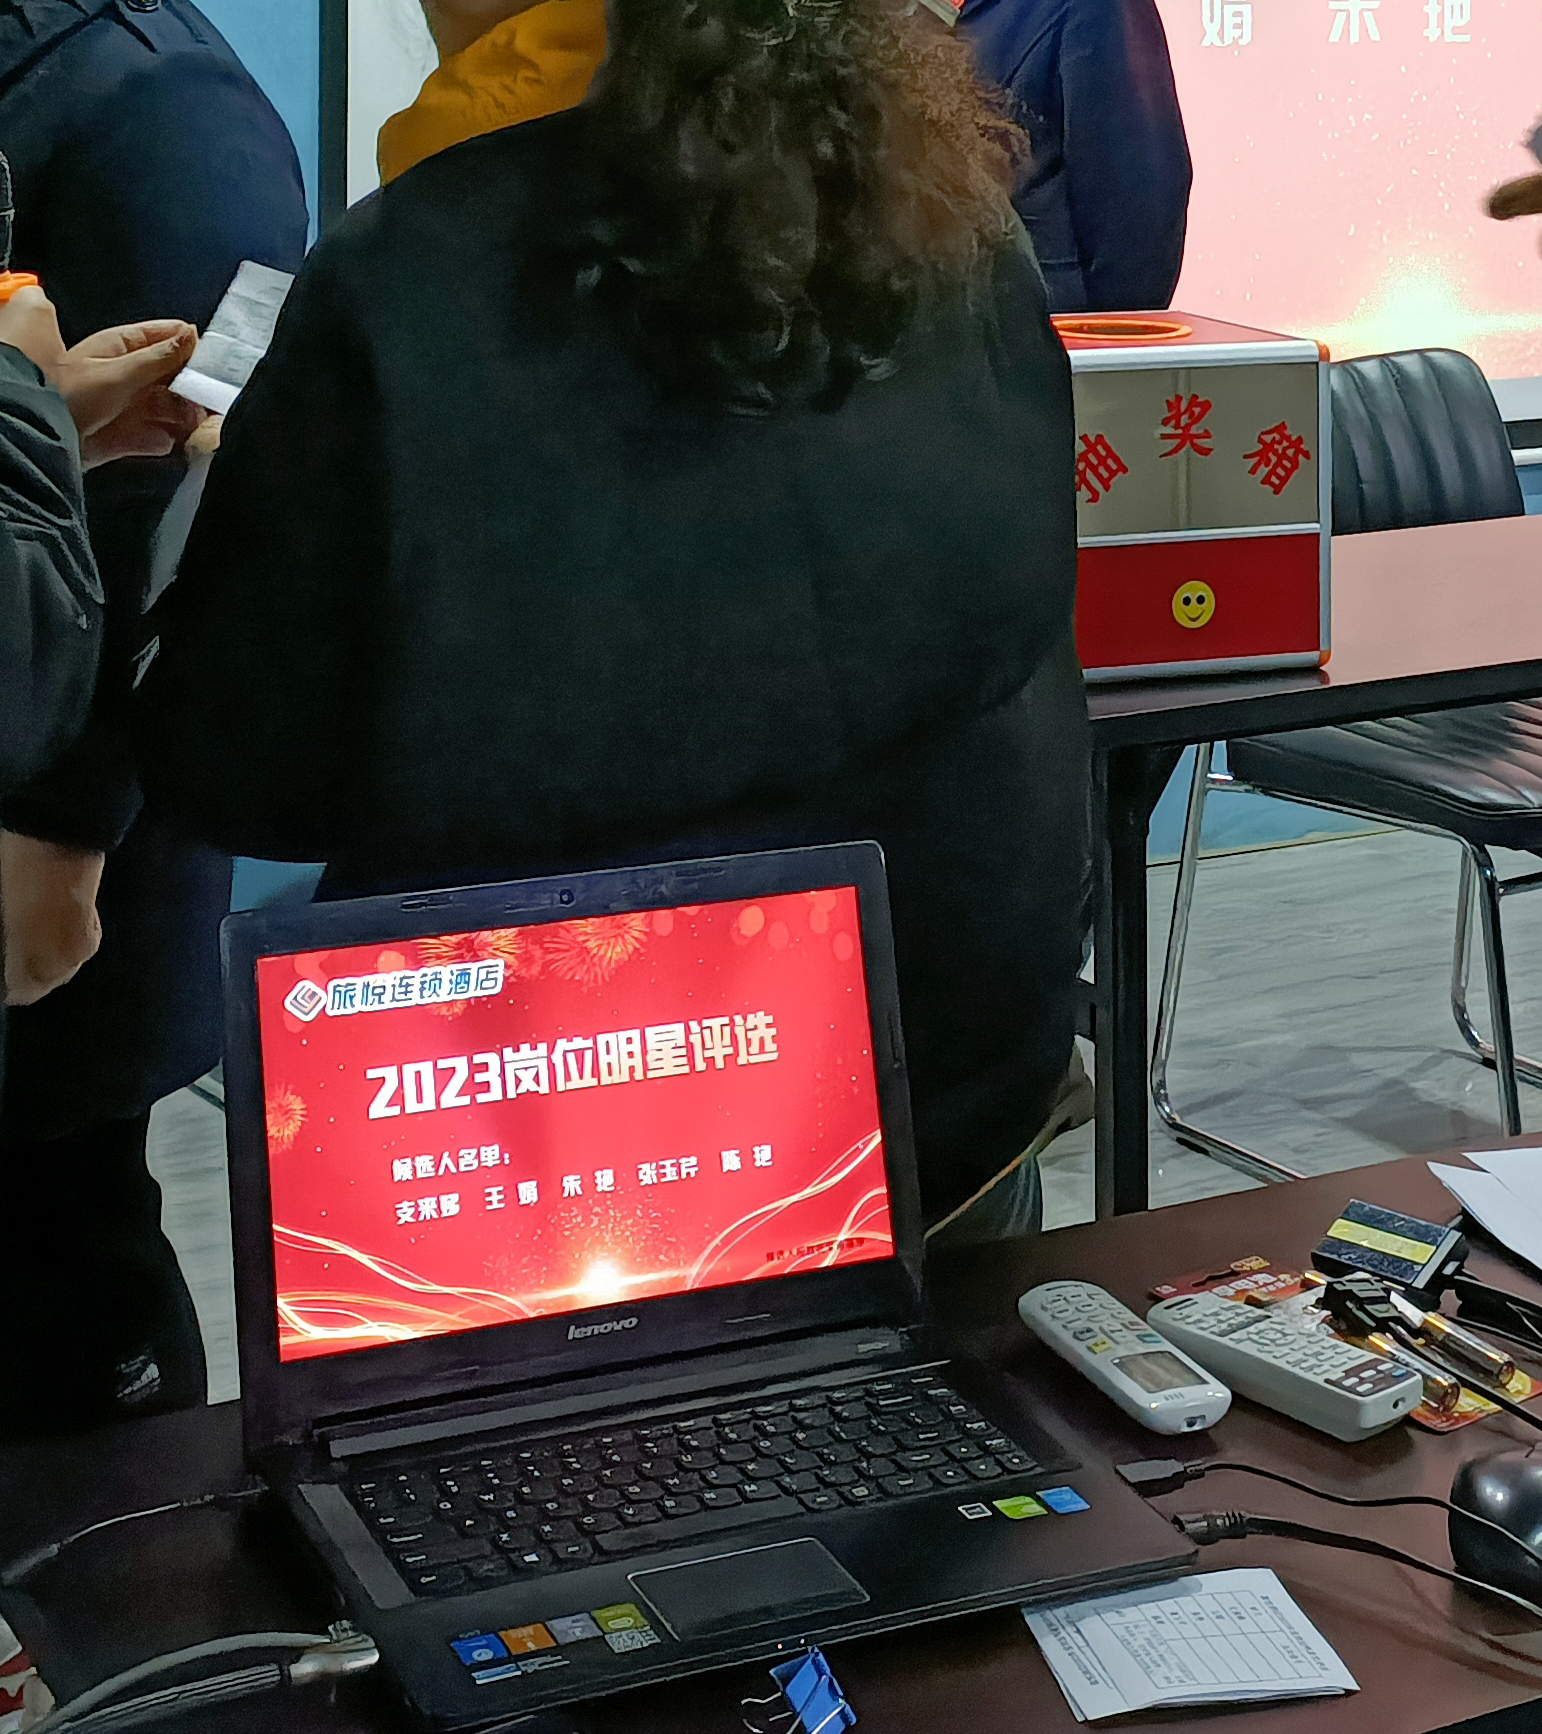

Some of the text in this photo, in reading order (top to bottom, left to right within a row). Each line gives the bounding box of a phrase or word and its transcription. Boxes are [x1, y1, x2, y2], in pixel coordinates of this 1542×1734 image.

[329, 963, 502, 1011] 旅悦连锁酒店
[364, 1010, 780, 1121] 2023岗位明星评选
[567, 1317, 639, 1340] lenovo
